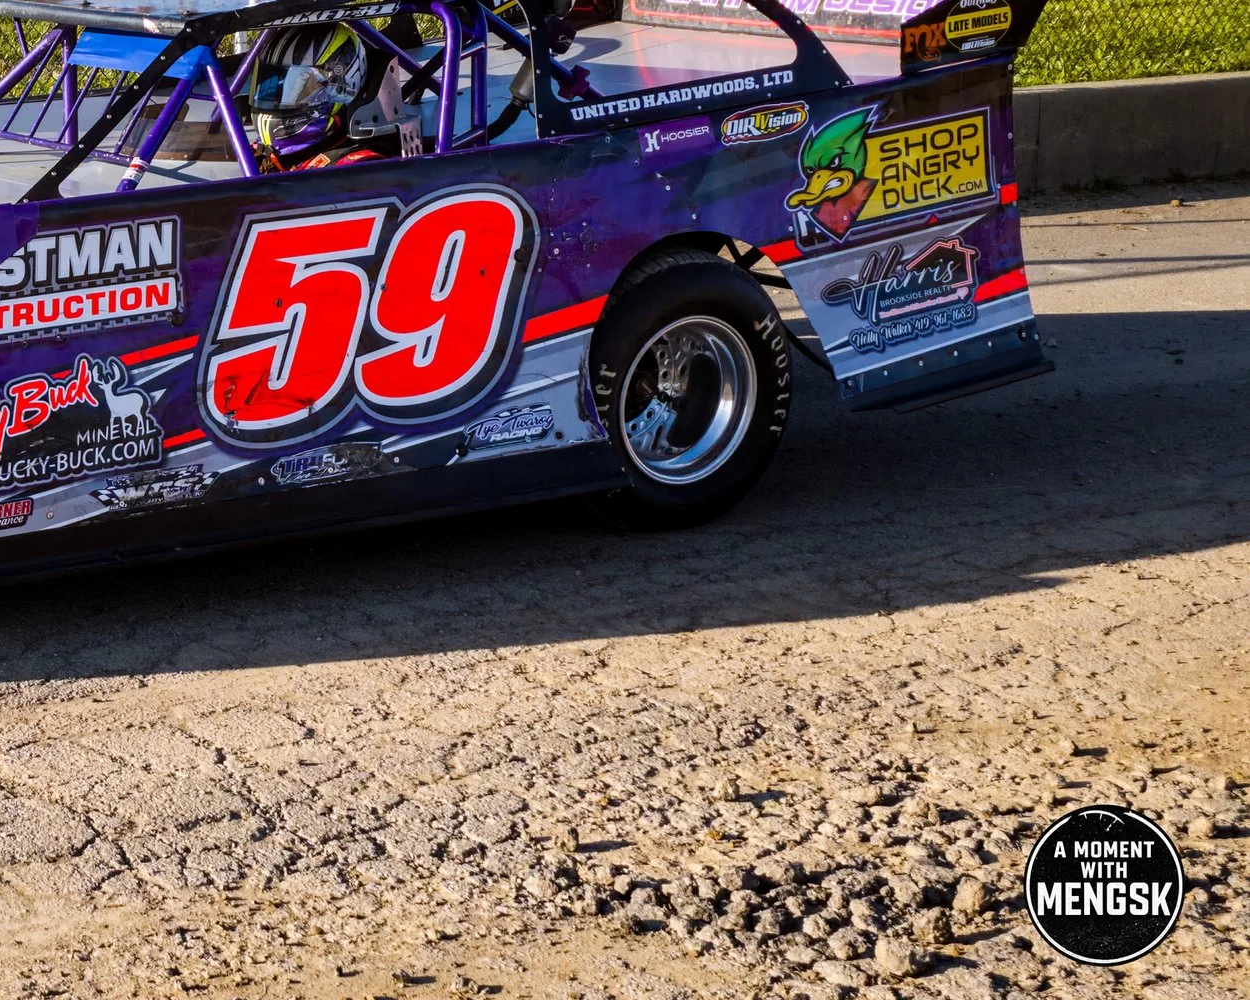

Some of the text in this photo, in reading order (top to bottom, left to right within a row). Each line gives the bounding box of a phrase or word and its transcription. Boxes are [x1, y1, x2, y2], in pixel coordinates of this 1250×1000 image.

[948, 11, 1008, 33] LATE MODELS
[903, 22, 947, 58] FOX
[570, 70, 793, 121] UNITED HARDWOODS, LTD
[661, 125, 710, 142] HOOSIER
[879, 123, 979, 162] SHOP
[881, 145, 980, 186] ANGRY
[882, 174, 983, 209] DUCK.COM
[824, 247, 962, 323] Harris
[880, 292, 922, 307] BROOKSIDE
[924, 285, 951, 297] REALTY
[207, 191, 524, 431] 59
[7, 359, 99, 436] Buck
[77, 416, 156, 446] MINERAL
[466, 418, 500, 439] Tye
[490, 426, 543, 442] RACING
